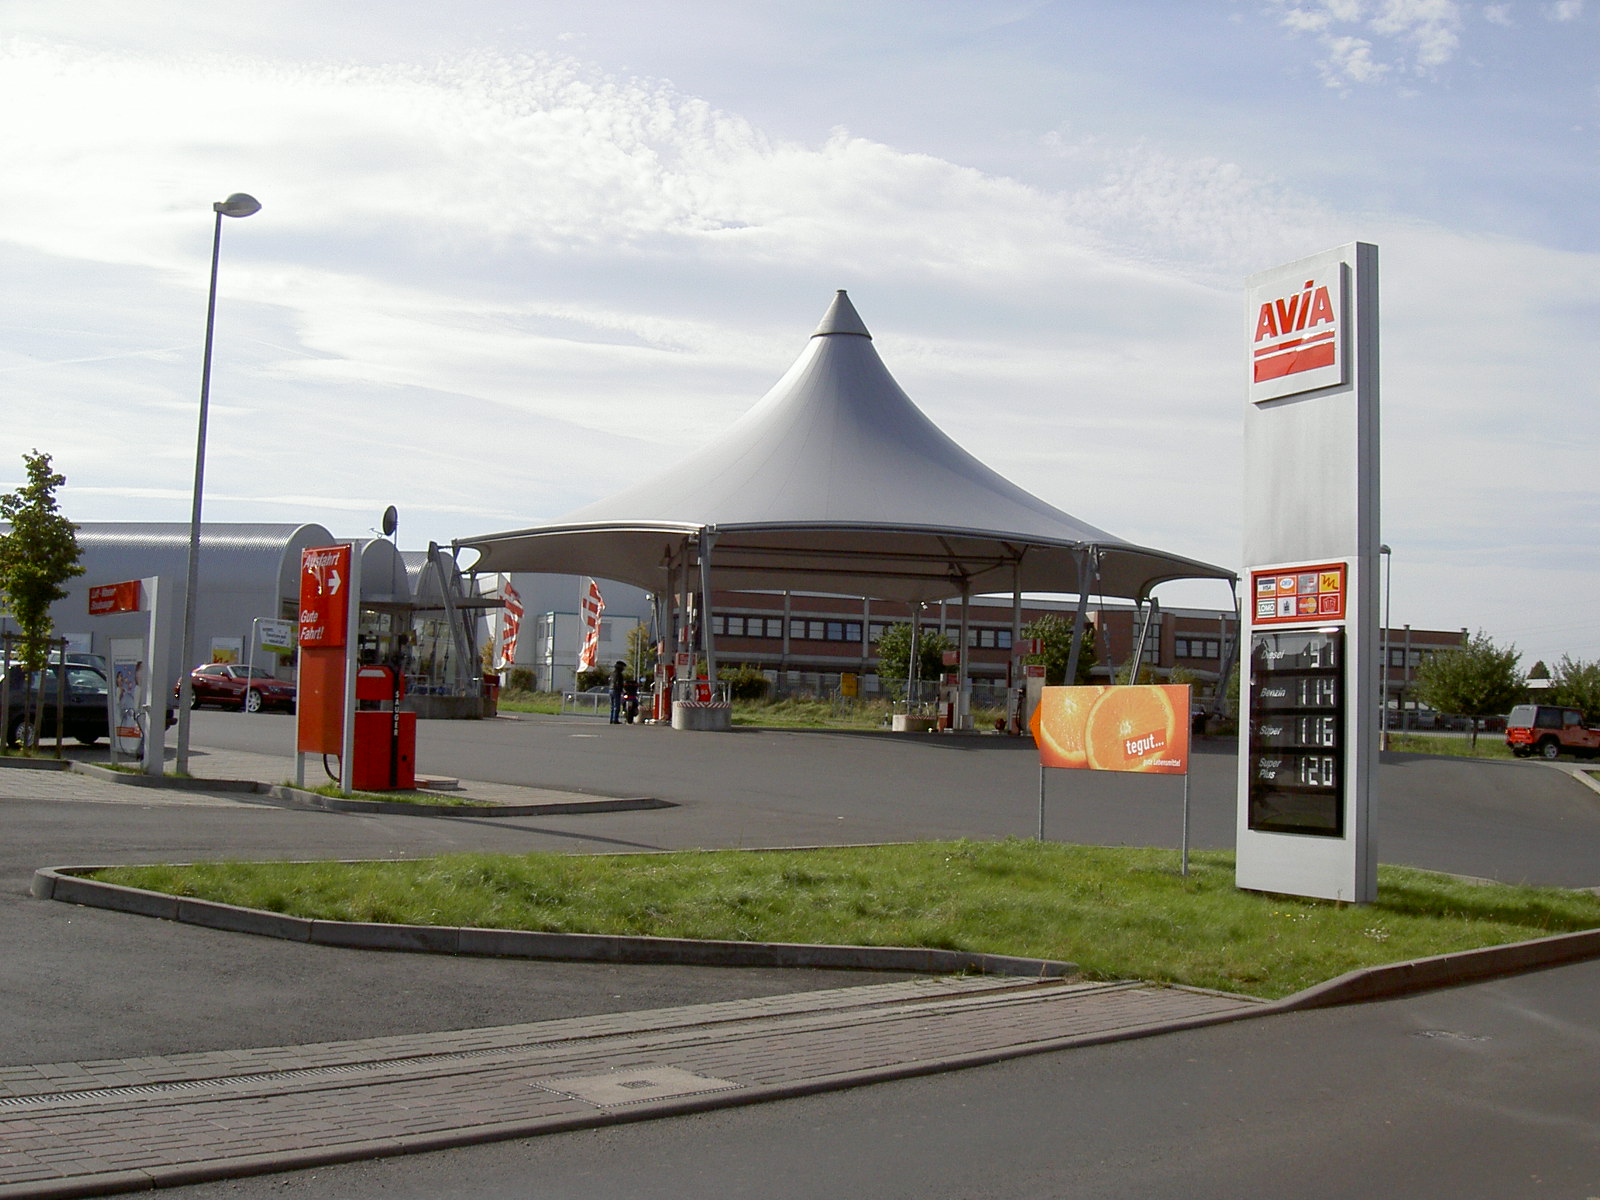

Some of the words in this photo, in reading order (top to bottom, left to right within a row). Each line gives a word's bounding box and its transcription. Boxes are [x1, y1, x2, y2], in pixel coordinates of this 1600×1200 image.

[1254, 280, 1335, 343] AVIA
[304, 552, 340, 568] Ausfahrt
[301, 609, 319, 623] Gute
[301, 626, 325, 640] Fahrt!
[1260, 687, 1286, 698] Benzin
[1302, 679, 1334, 706] 114
[1259, 725, 1283, 737] Super
[1302, 717, 1334, 747] 116
[1258, 757, 1282, 769] Super
[1301, 756, 1333, 786] 120
[1258, 769, 1276, 780] Plus
